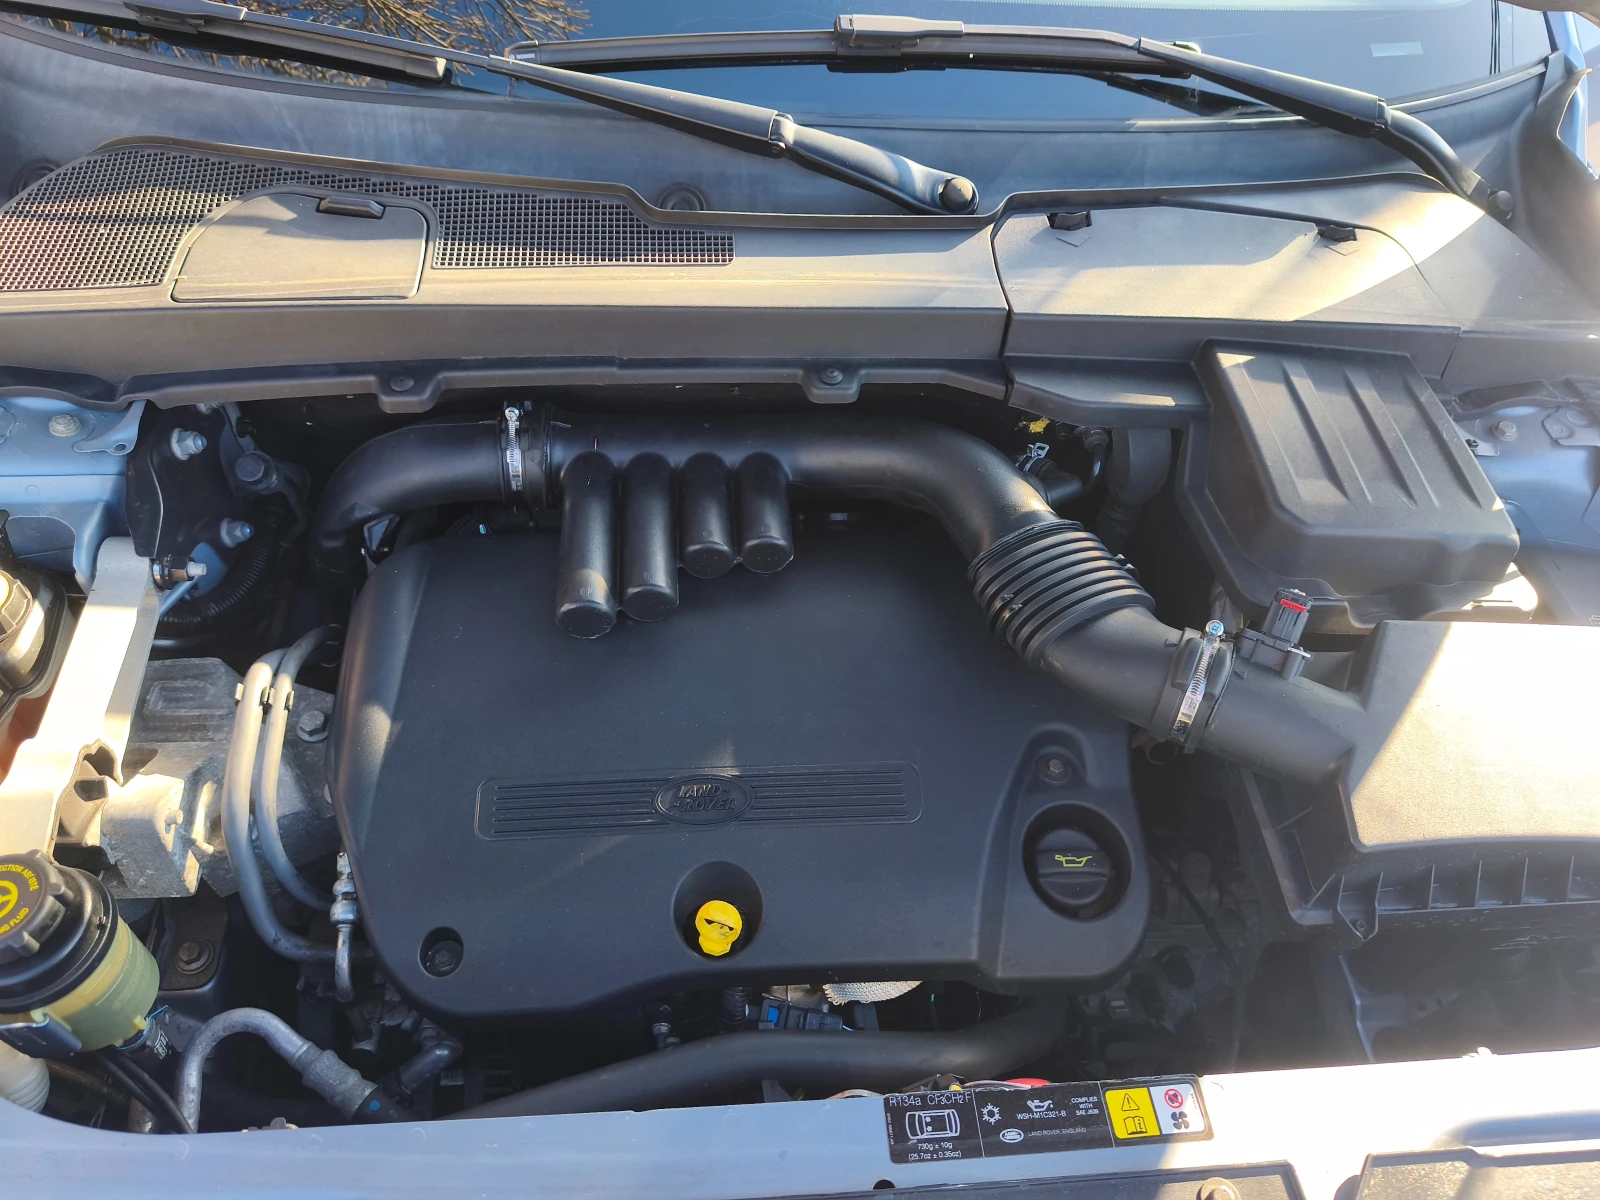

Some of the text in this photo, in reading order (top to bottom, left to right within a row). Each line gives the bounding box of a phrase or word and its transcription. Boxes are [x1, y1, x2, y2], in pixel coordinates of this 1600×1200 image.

[678, 784, 721, 797] LAND
[681, 798, 736, 812] ROVER
[9, 907, 29, 927] FLUID
[889, 1095, 921, 1107] R134a
[1071, 1096, 1098, 1104] COMPLIES
[1016, 1110, 1067, 1120] WSH-M1C321-B
